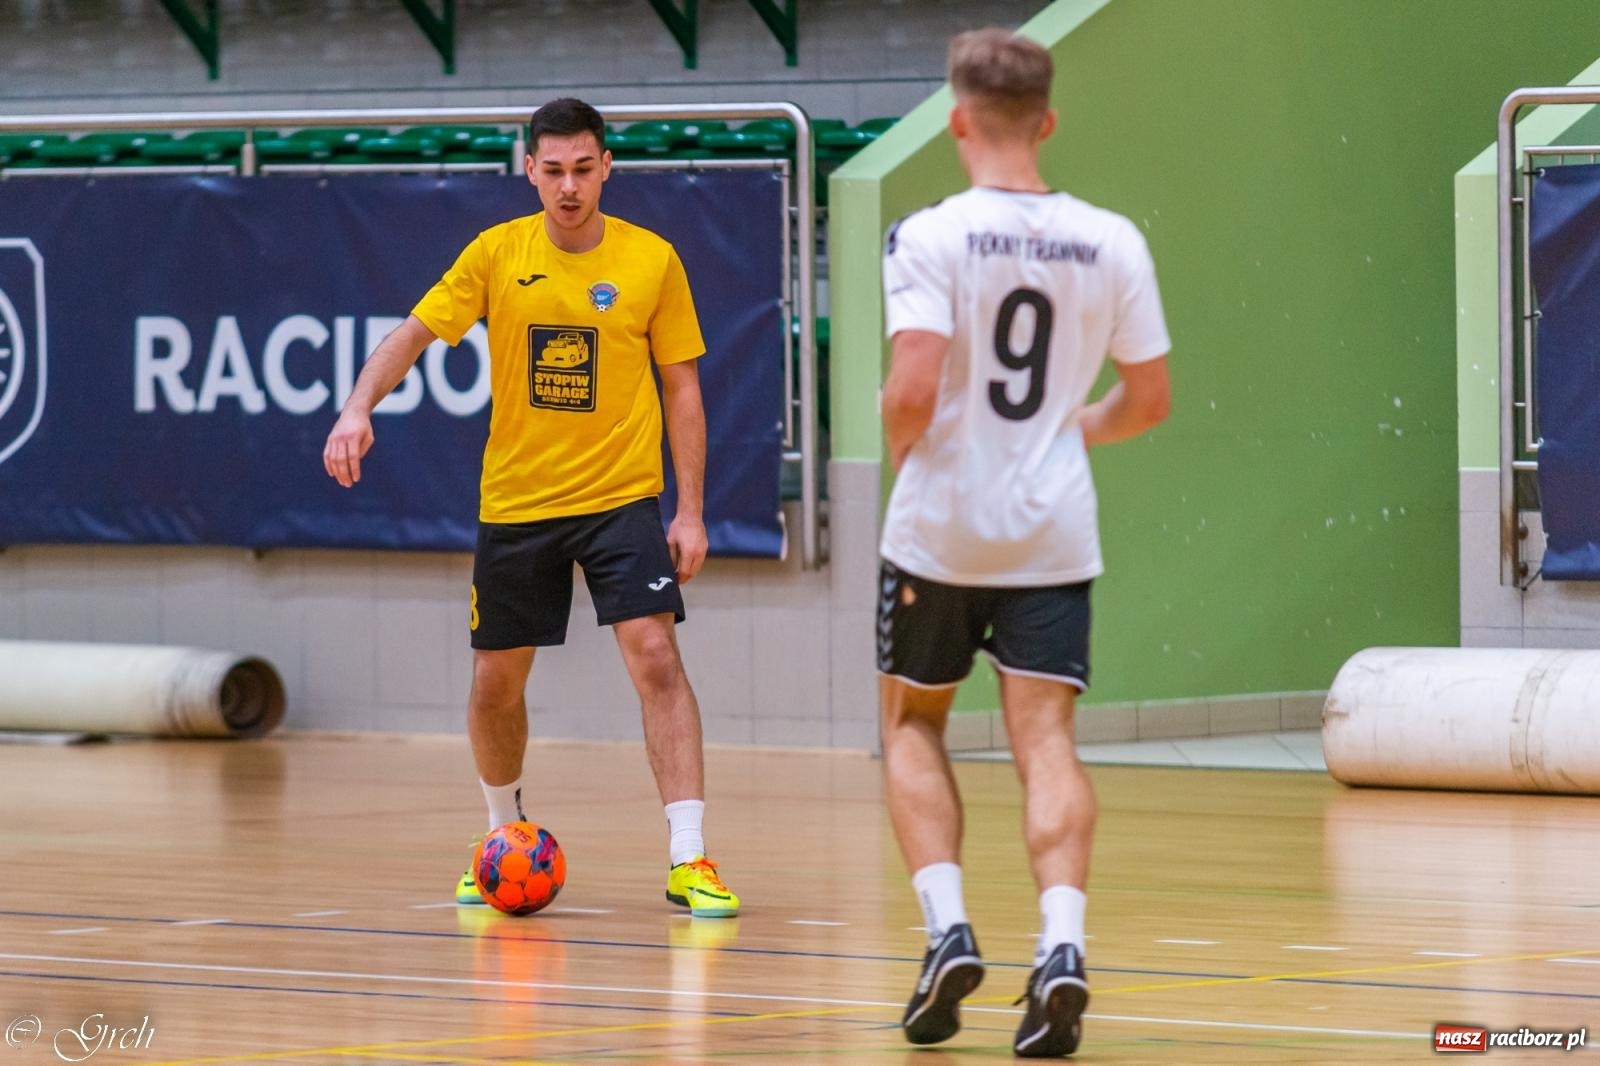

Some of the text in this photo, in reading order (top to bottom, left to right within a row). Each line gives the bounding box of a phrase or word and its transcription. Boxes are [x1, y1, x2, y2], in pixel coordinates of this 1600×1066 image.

[988, 288, 1055, 421] 9
[534, 372, 590, 387] STOPIW
[534, 384, 590, 400] GARAGE
